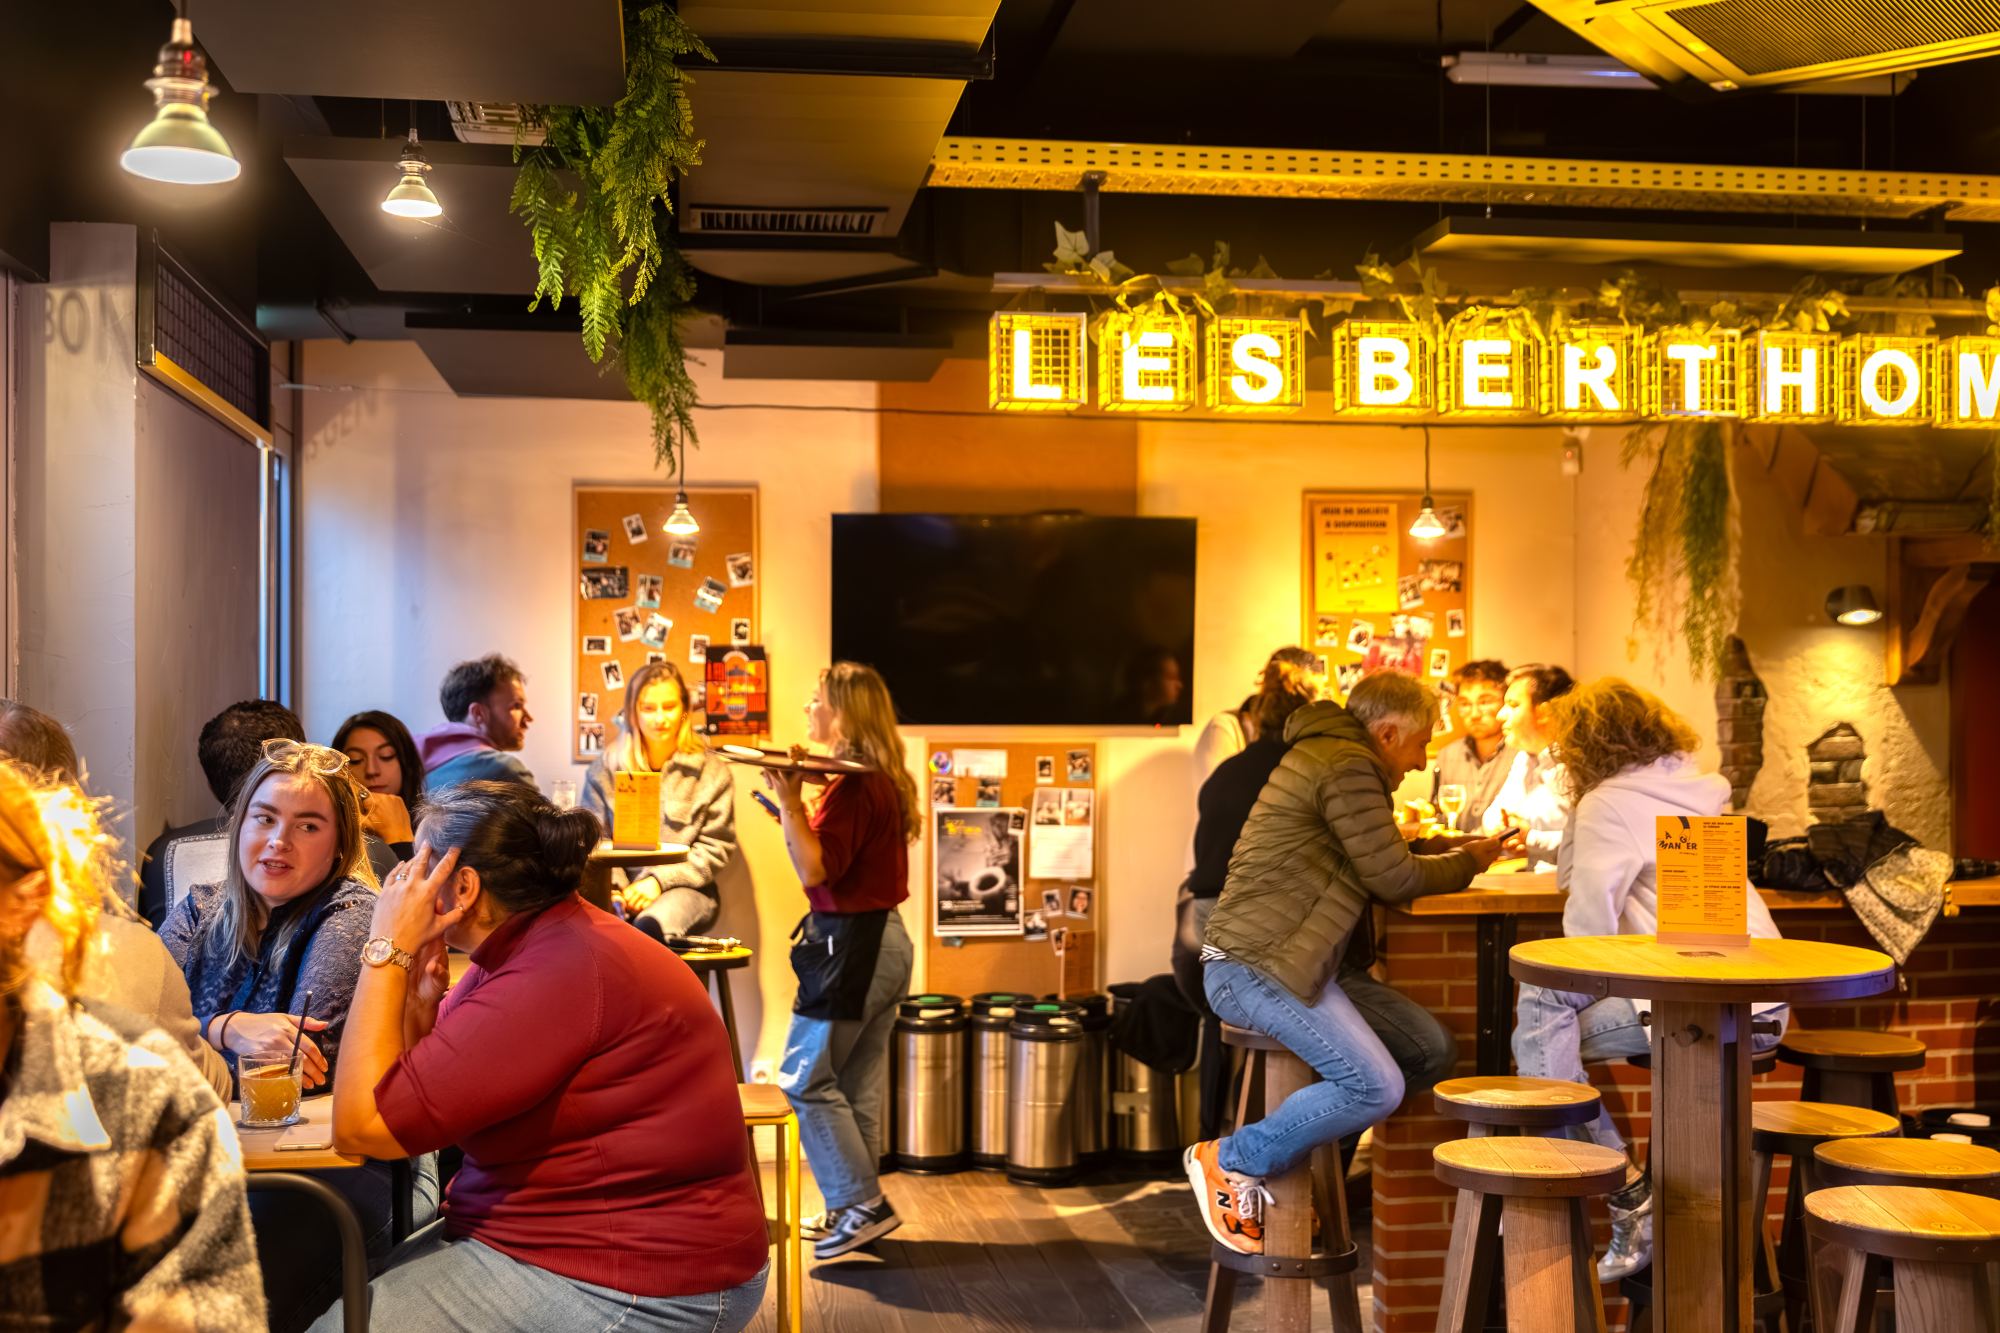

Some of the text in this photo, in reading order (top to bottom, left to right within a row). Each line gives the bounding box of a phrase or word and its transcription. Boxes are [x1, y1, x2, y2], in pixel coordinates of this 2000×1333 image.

[1013, 329, 2000, 418] LES BERTHOM
[1216, 1189, 1232, 1209] N
